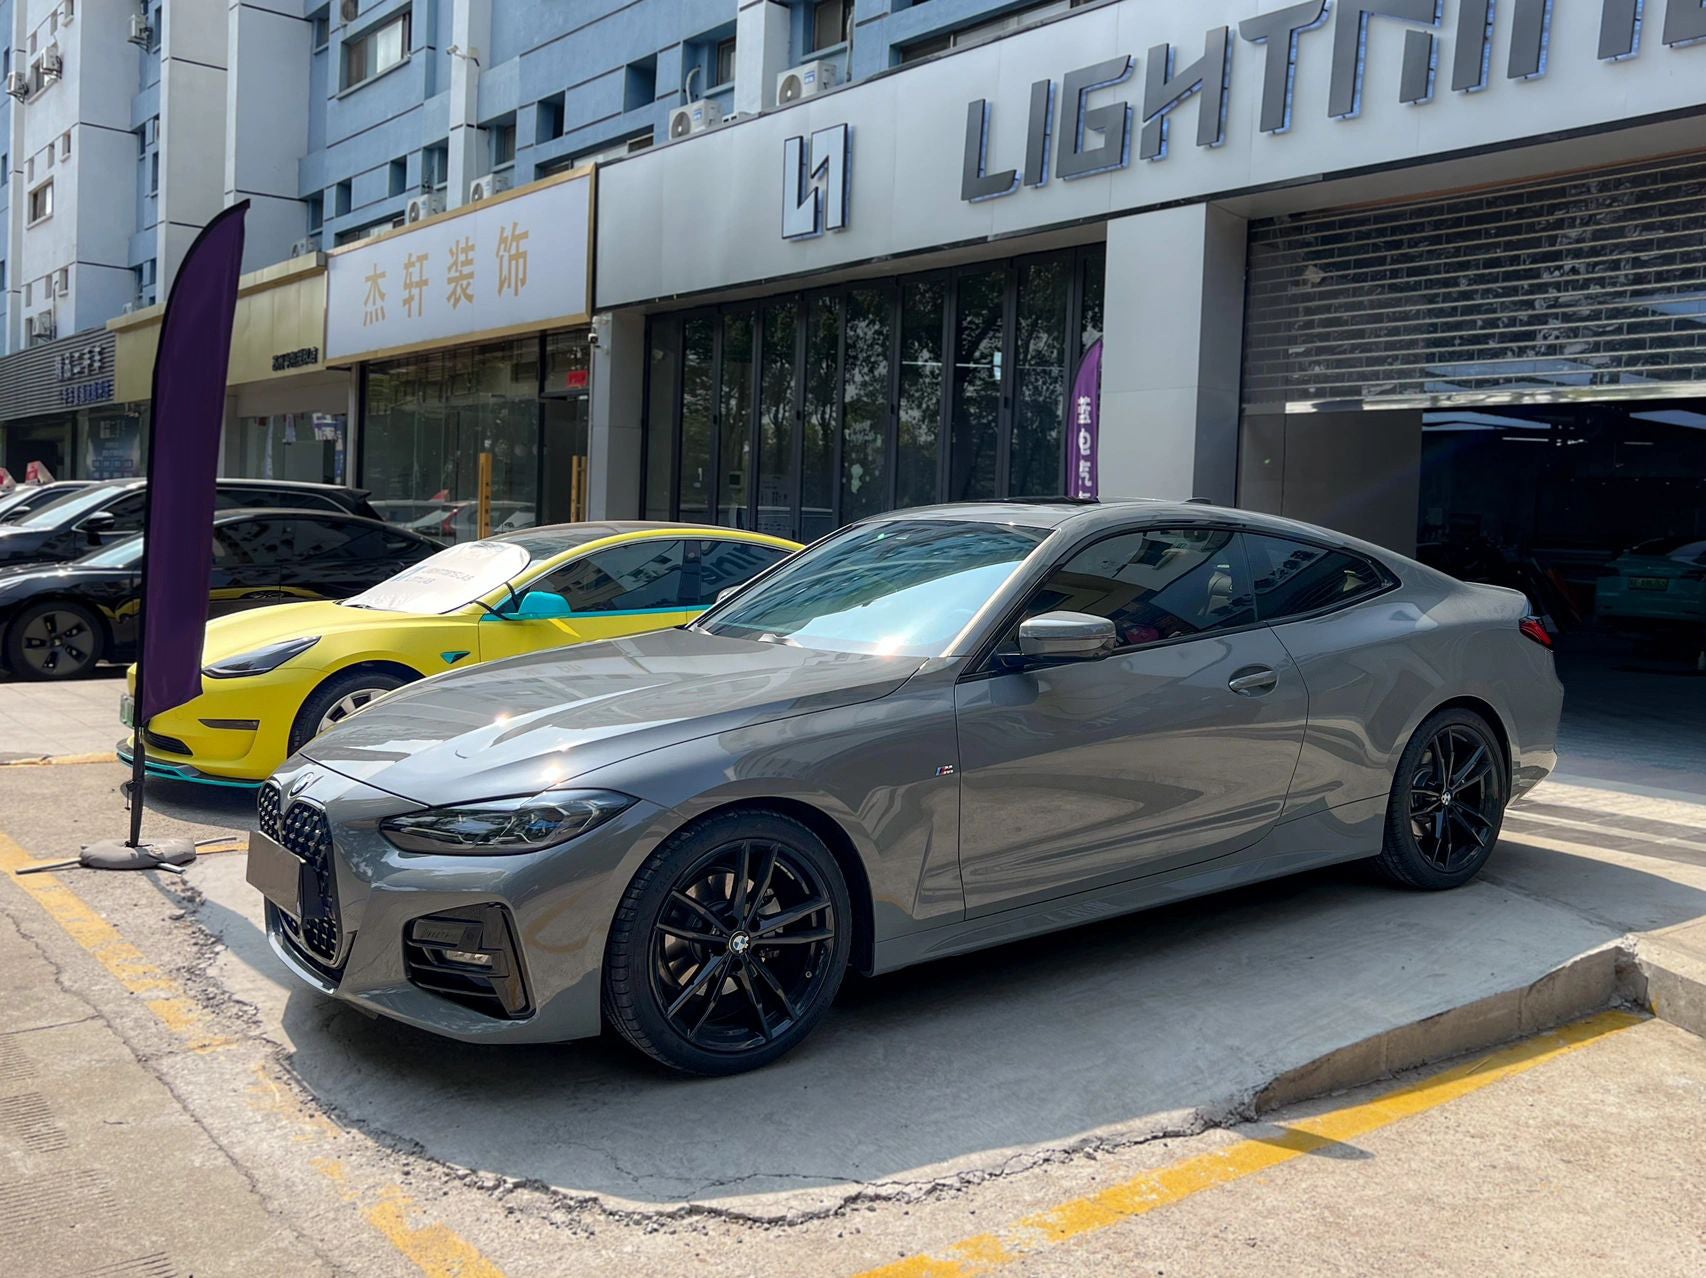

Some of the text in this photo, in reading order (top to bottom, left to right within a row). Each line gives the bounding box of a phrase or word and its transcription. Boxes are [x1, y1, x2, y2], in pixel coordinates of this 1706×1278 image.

[961, 0, 1706, 203] LIGHTNI
[363, 222, 529, 327] 杰轩装饰
